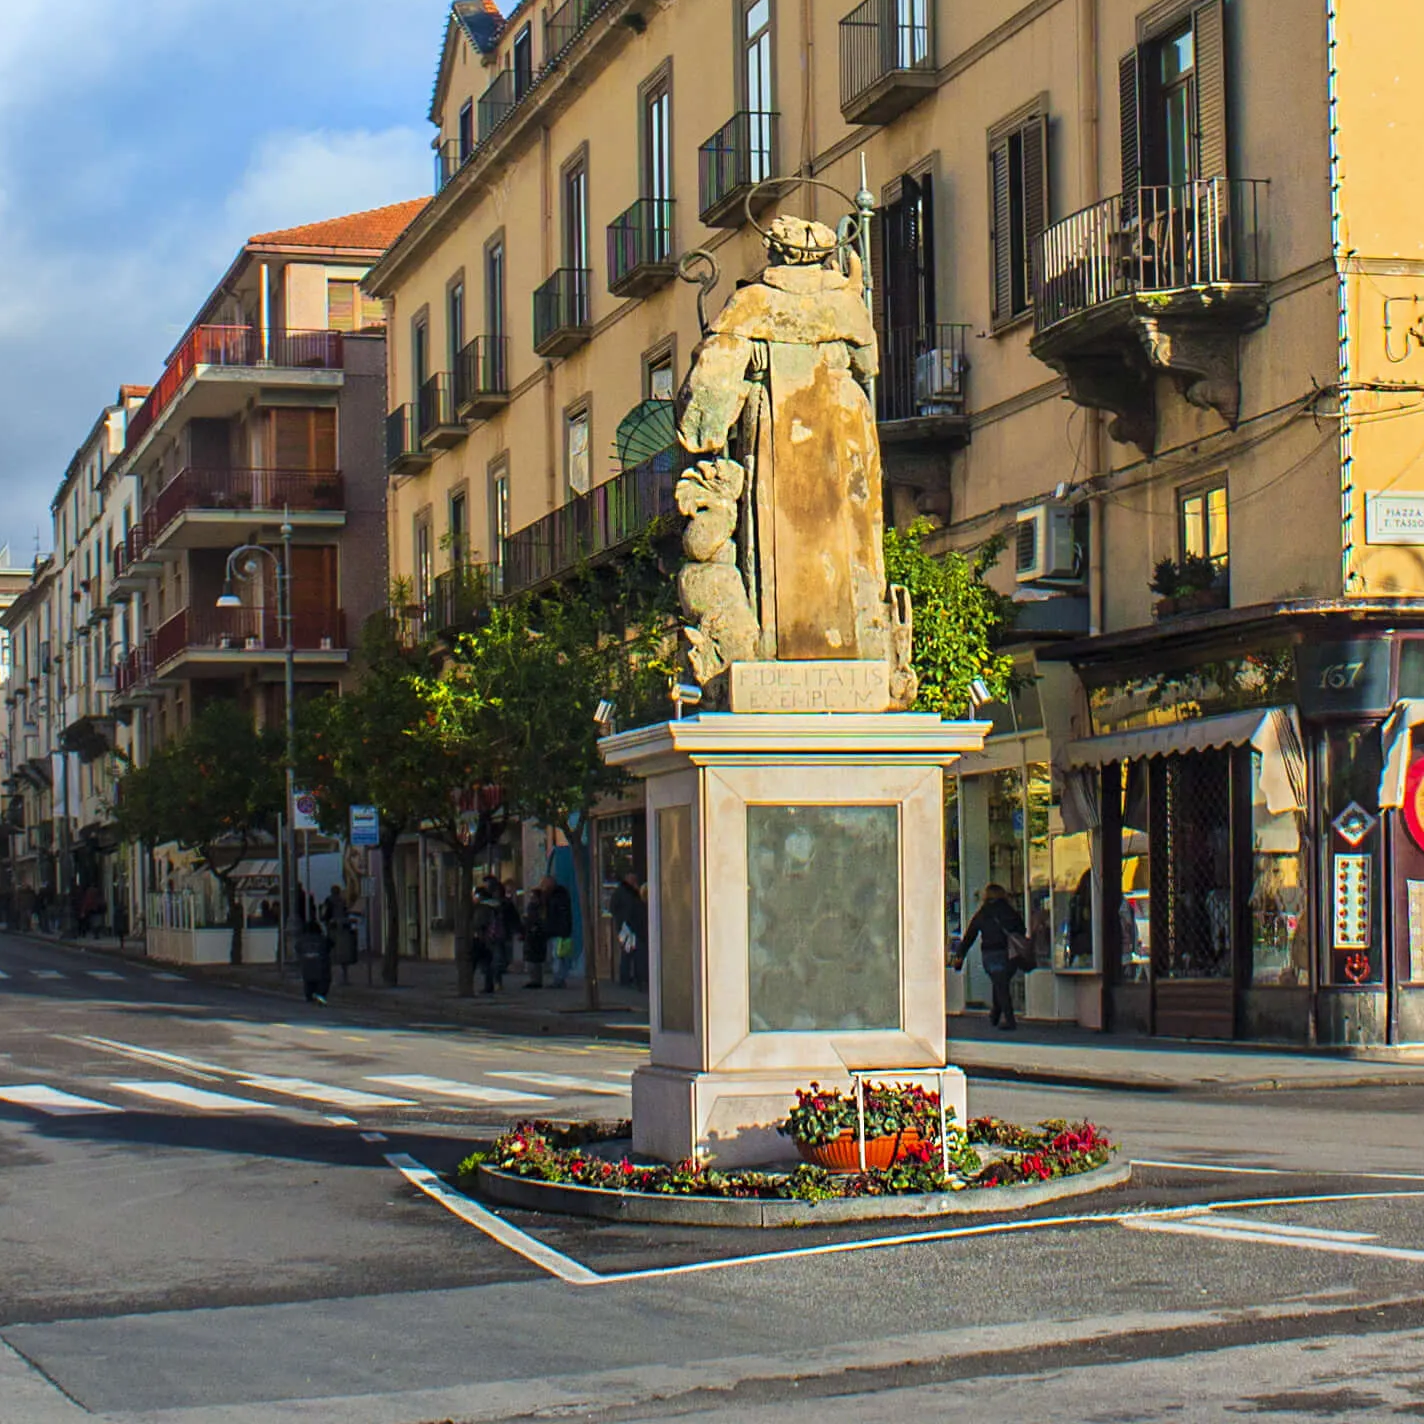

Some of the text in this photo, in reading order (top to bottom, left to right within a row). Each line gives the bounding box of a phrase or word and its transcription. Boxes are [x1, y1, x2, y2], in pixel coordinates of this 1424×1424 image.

[1385, 507, 1423, 517] PIAZZA
[1394, 518, 1424, 528] TASSO
[738, 666, 884, 687] FIDELITATIS
[1319, 661, 1364, 689] 167
